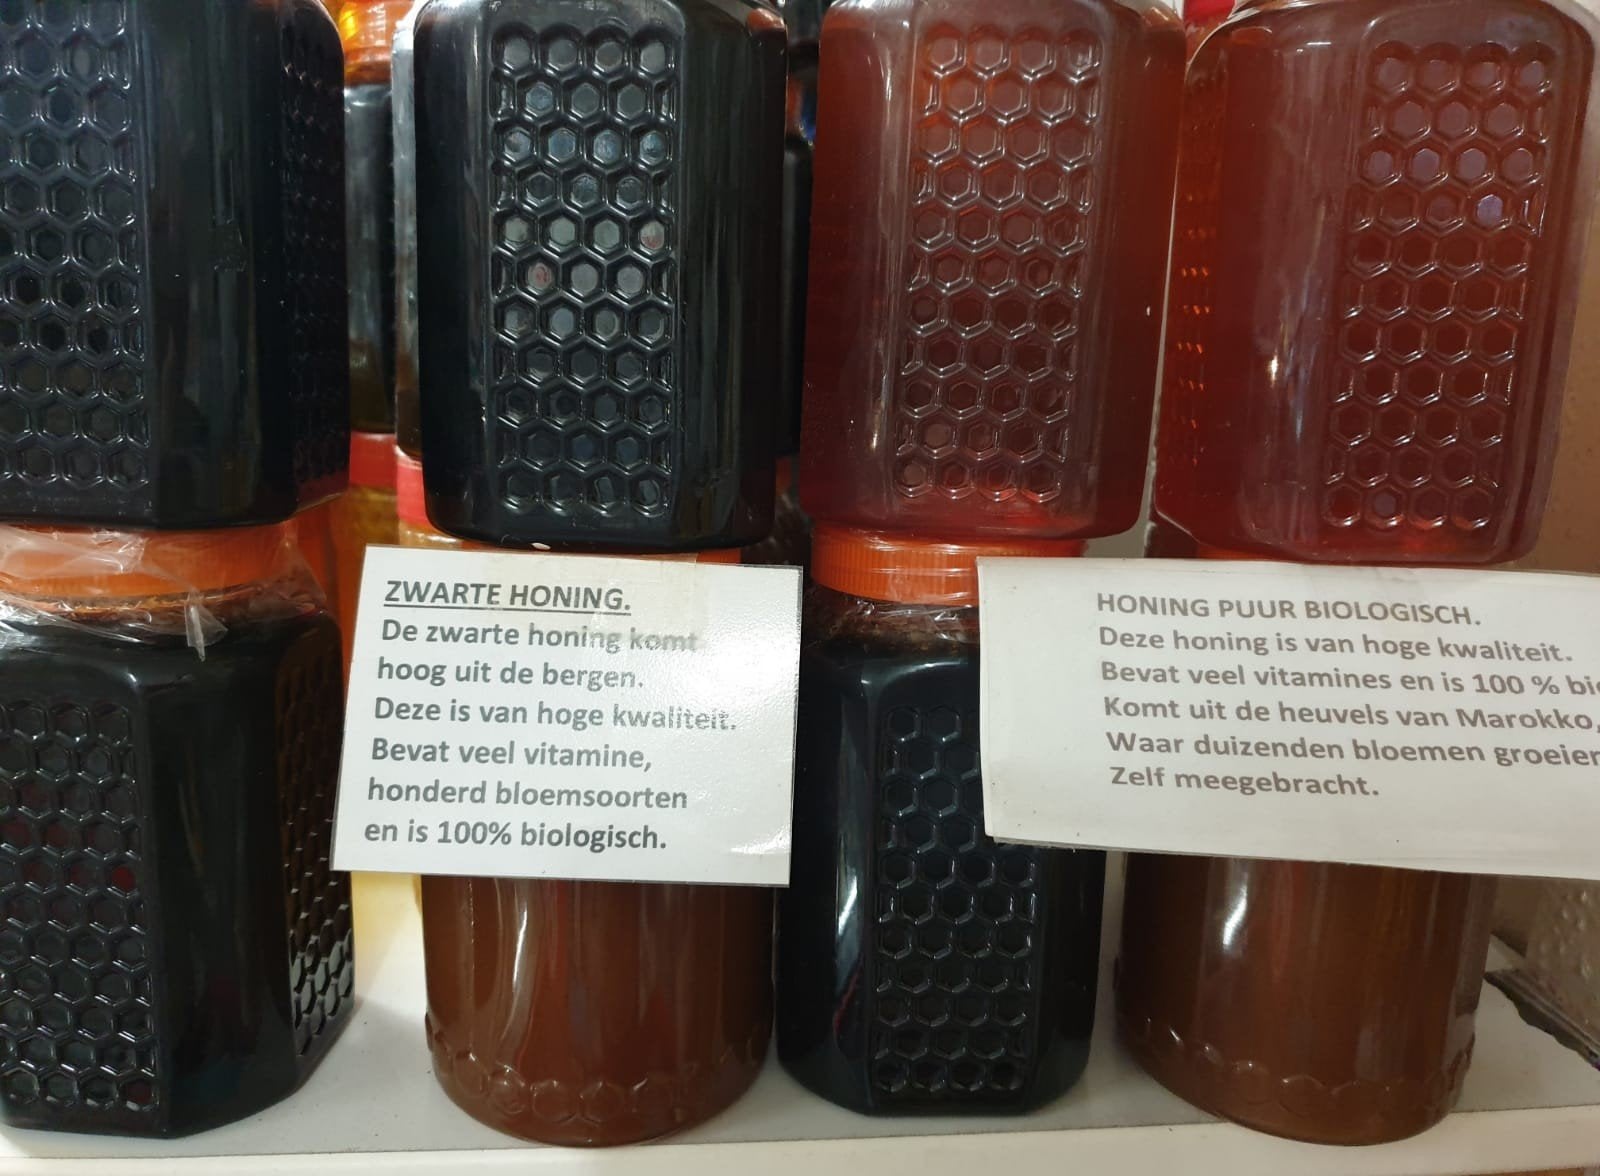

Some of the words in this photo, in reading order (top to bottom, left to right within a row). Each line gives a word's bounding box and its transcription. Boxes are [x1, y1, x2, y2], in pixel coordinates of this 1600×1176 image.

[384, 580, 501, 605] ZWARTE
[509, 584, 632, 611] HONING.
[1097, 593, 1210, 617] HONING
[1218, 599, 1297, 619] PUUR
[1304, 600, 1481, 626] BIOLOGISCH.
[382, 618, 418, 642] De
[425, 623, 520, 645] zwarte
[528, 622, 622, 654] honing
[630, 626, 699, 652] komt
[1099, 626, 1165, 648] Deze
[1173, 629, 1269, 656] honing
[1275, 632, 1298, 652] is
[1305, 637, 1354, 653] van
[1362, 634, 1431, 660] hoge
[1437, 637, 1573, 662] kwaliteit.
[377, 655, 447, 687] hoog
[455, 660, 491, 683] uit
[500, 660, 534, 684] de
[542, 662, 644, 692] bergen.
[1101, 661, 1180, 683] Bevat
[1188, 664, 1245, 685] veel
[1254, 666, 1392, 690] vitamines
[1400, 674, 1434, 692] en
[1441, 672, 1465, 692] is
[1472, 674, 1525, 695] 100
[1531, 675, 1560, 695] %
[375, 697, 441, 721] Deze
[450, 698, 471, 722] is
[479, 705, 528, 724] van
[537, 700, 604, 731] hoge
[613, 703, 736, 731] kwaliteit.
[1104, 696, 1180, 718] Komt
[1189, 699, 1227, 720] uit
[1235, 700, 1270, 721] de
[1278, 701, 1389, 725] heuvels
[1396, 710, 1449, 727] van
[371, 737, 450, 763] Bevat
[458, 740, 515, 764] veel
[524, 742, 652, 772] vitamine,
[1106, 731, 1184, 753] Waar
[1193, 734, 1345, 759] duizenden
[1352, 738, 1486, 761] bloemen
[368, 776, 487, 804] honderd
[495, 780, 688, 809] bloemsoorten
[1110, 767, 1165, 787] Zelf
[1174, 771, 1380, 796] meegebracht.
[364, 822, 398, 842] en
[407, 818, 429, 843] is
[437, 820, 512, 846] 100%
[520, 821, 666, 853] biologisch.
